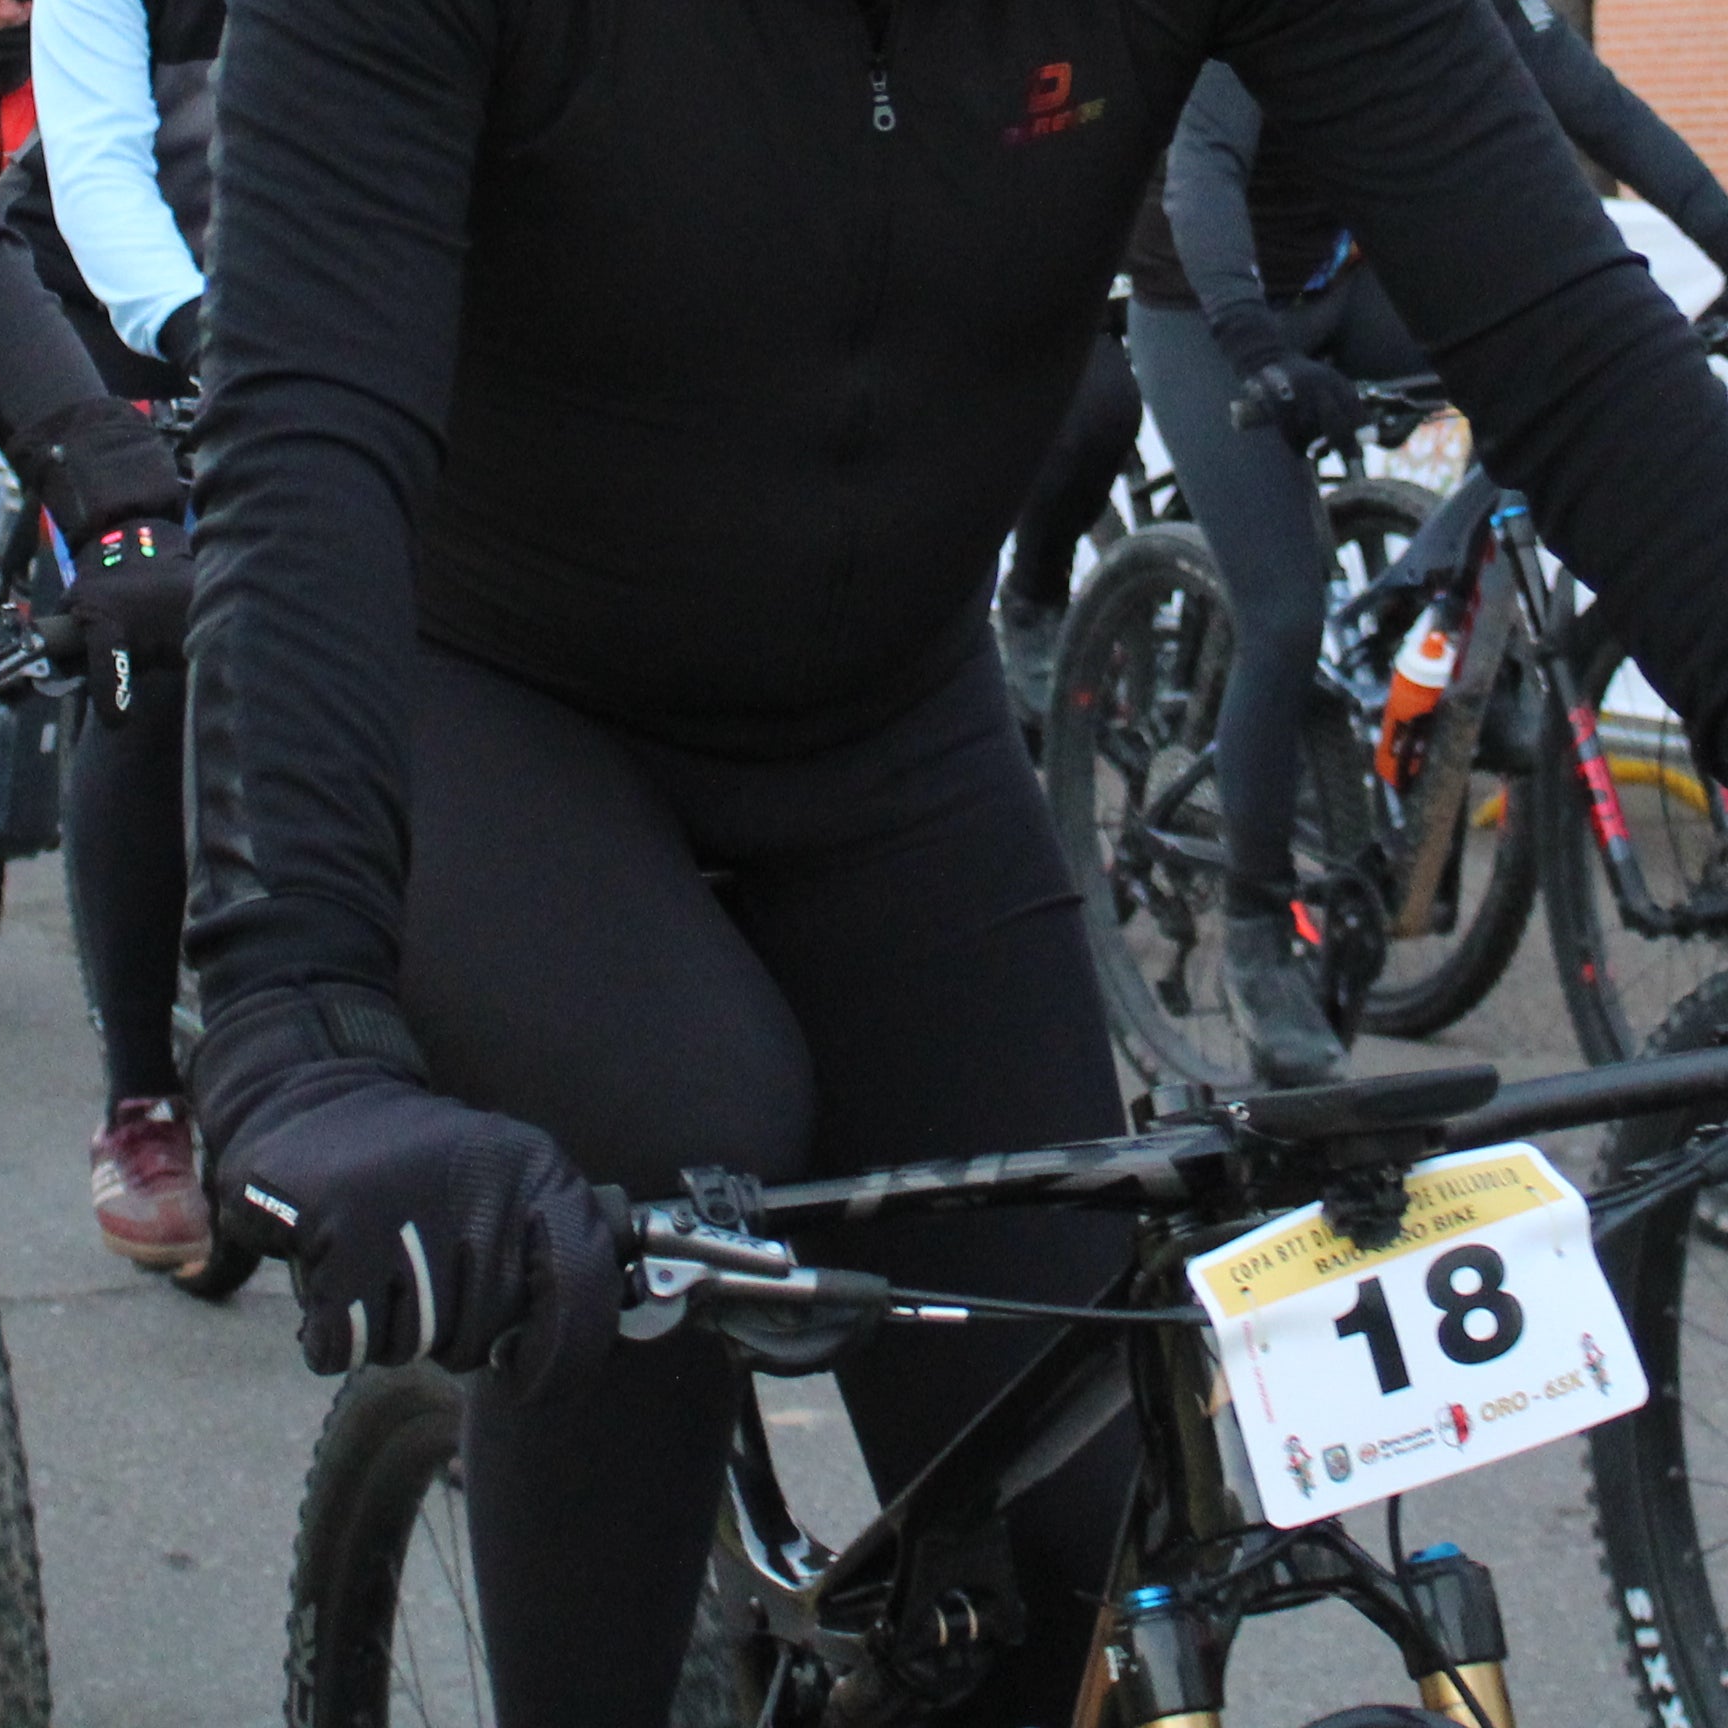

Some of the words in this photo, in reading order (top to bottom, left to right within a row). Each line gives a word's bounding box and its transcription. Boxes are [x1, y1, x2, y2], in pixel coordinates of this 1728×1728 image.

[1433, 1203, 1480, 1235] BIKE
[1228, 1250, 1273, 1285] COPA
[1274, 1232, 1313, 1266] BTT
[1333, 1242, 1527, 1397] 18
[1479, 1389, 1531, 1425] ORO
[1544, 1371, 1587, 1402] 65K
